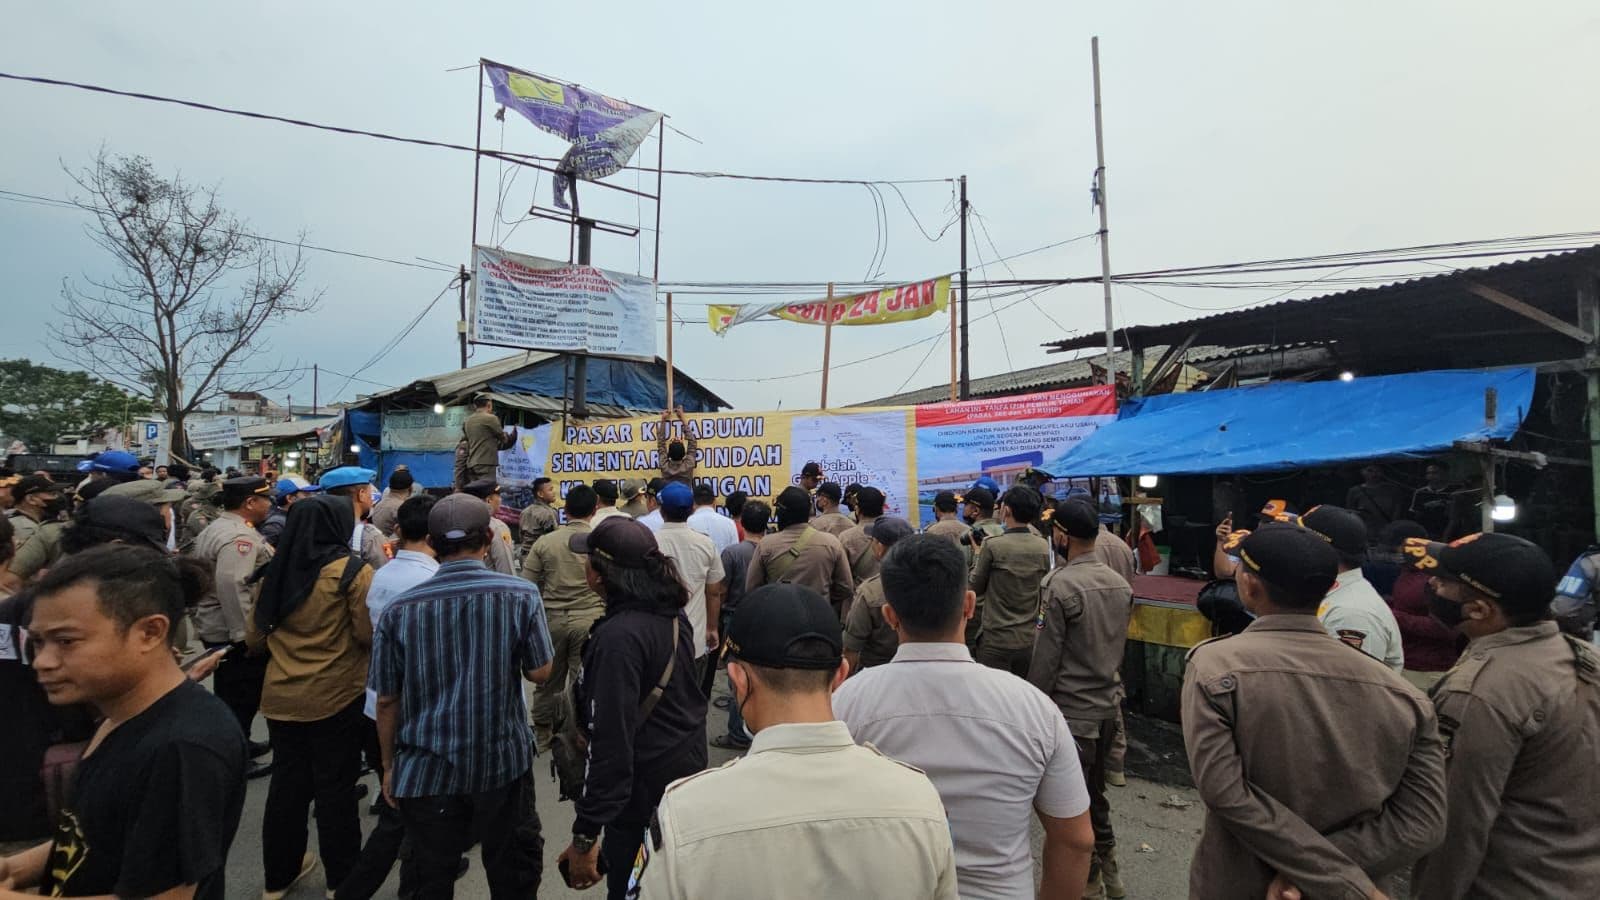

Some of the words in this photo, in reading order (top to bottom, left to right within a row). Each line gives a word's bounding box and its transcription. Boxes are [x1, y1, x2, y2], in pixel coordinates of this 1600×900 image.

[848, 291, 881, 318] 24
[567, 424, 634, 445] PASAR
[957, 440, 1005, 448] PENAMPUNGAN
[1005, 437, 1042, 445] PEDAGANG
[1042, 435, 1082, 443] SEMENTARA
[996, 431, 1022, 439] SEGERA
[551, 449, 660, 473] SEMENTAR
[831, 472, 869, 485] Apple
